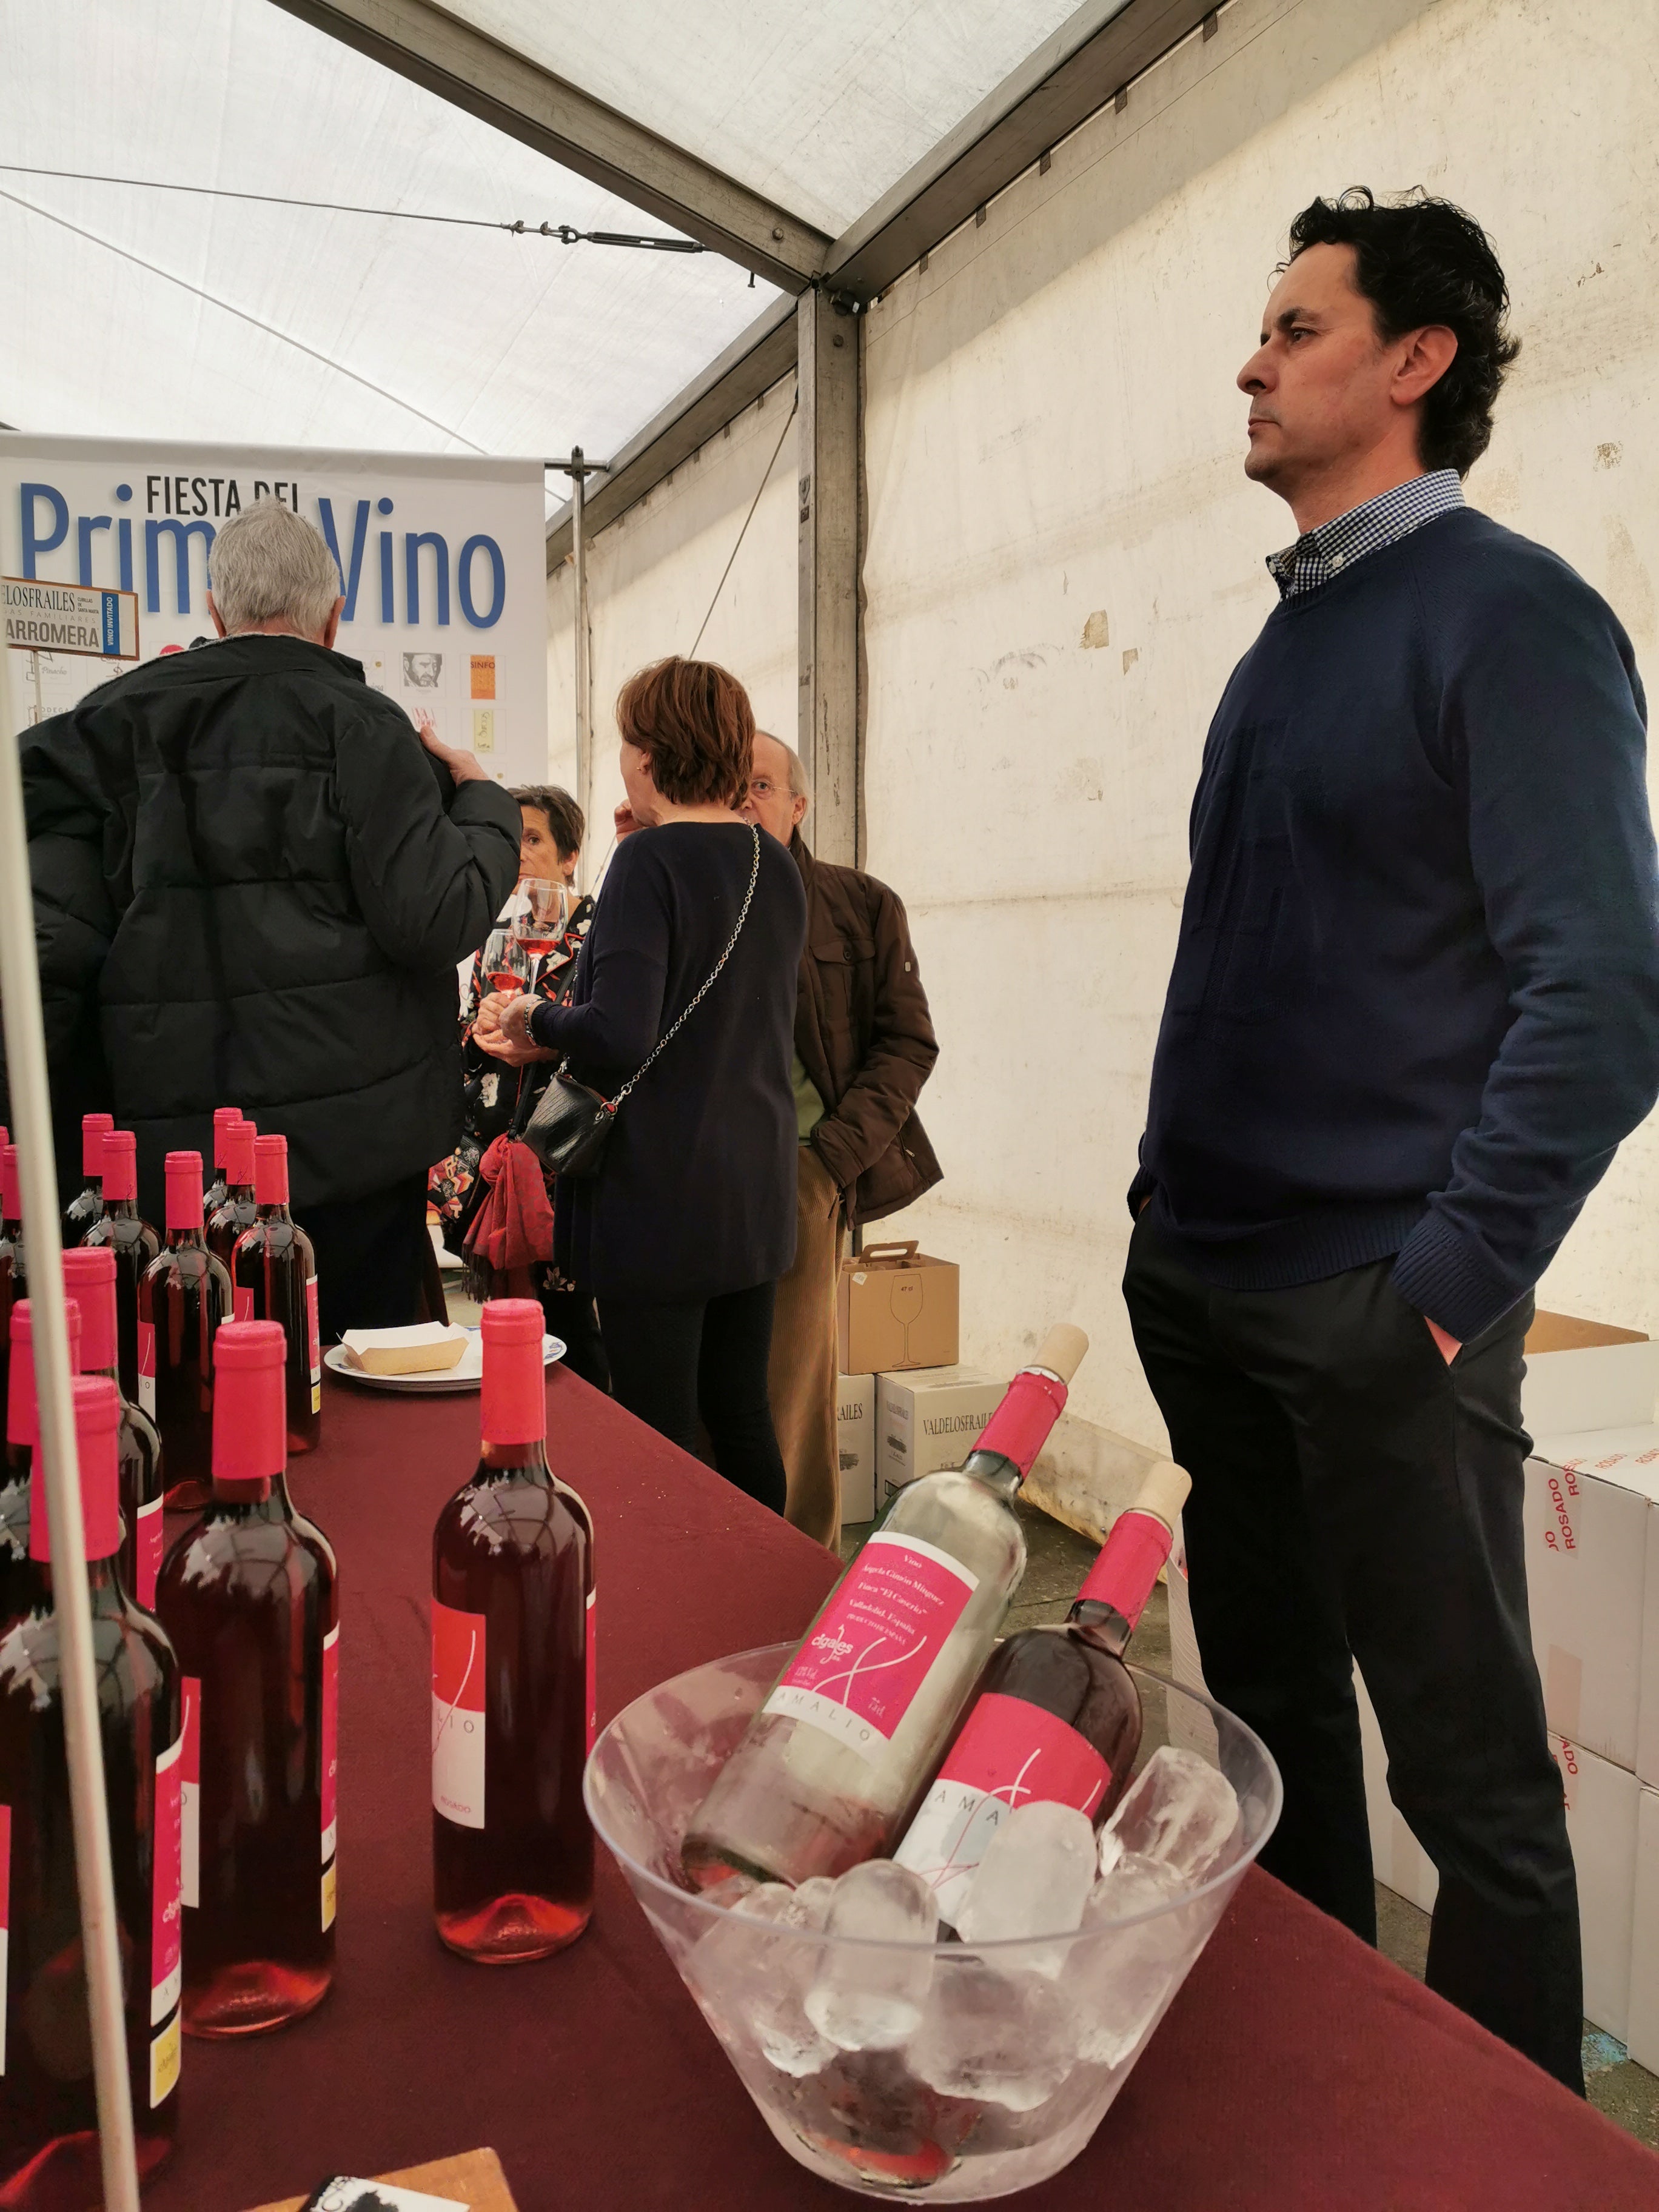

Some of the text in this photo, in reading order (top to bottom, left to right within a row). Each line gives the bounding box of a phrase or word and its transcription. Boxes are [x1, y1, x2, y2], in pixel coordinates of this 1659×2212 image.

[147, 475, 242, 517] FIESTA
[20, 481, 506, 629] Prim Vino
[30, 611, 96, 623] FAMILIARES
[1548, 1478, 1576, 1550] ROSADO
[904, 1554, 922, 1569] Vino
[776, 1691, 871, 1741] AMALIO
